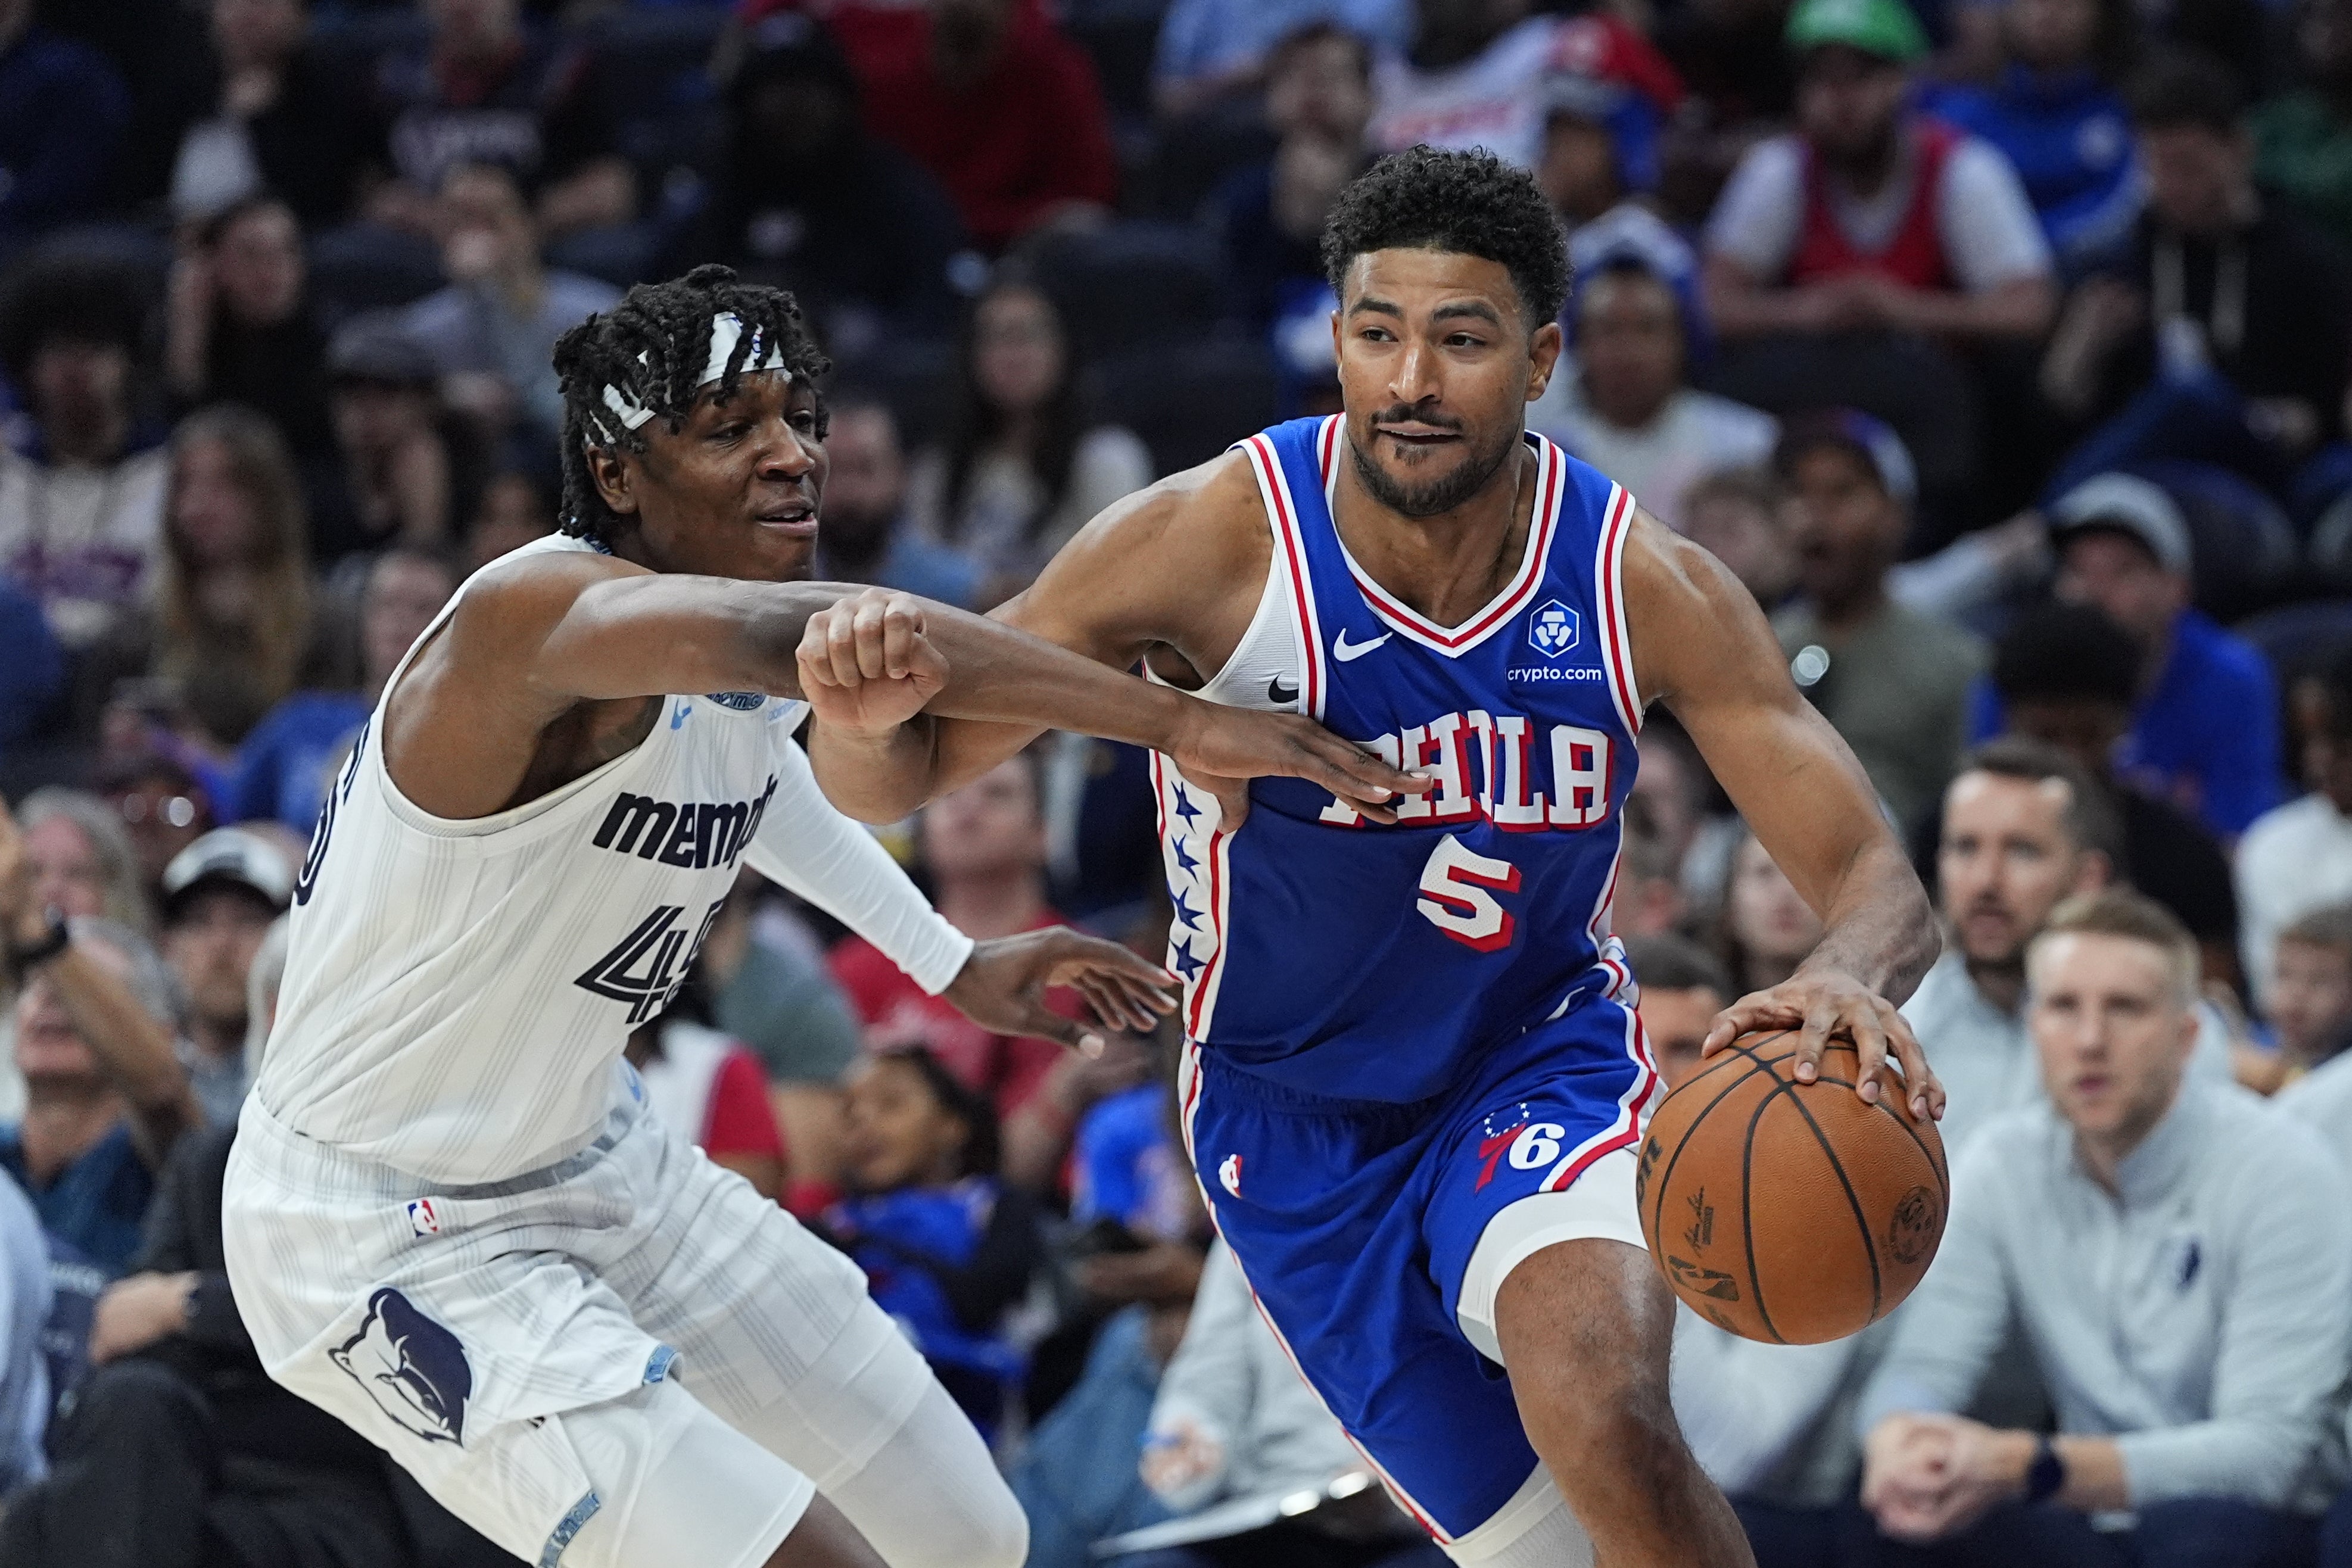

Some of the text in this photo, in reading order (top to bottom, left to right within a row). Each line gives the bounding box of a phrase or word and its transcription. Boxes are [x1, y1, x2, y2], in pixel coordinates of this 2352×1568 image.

[1507, 665, 1602, 683] crypto.com
[1416, 833, 1522, 953] 5
[1475, 1123, 1566, 1193] 76
